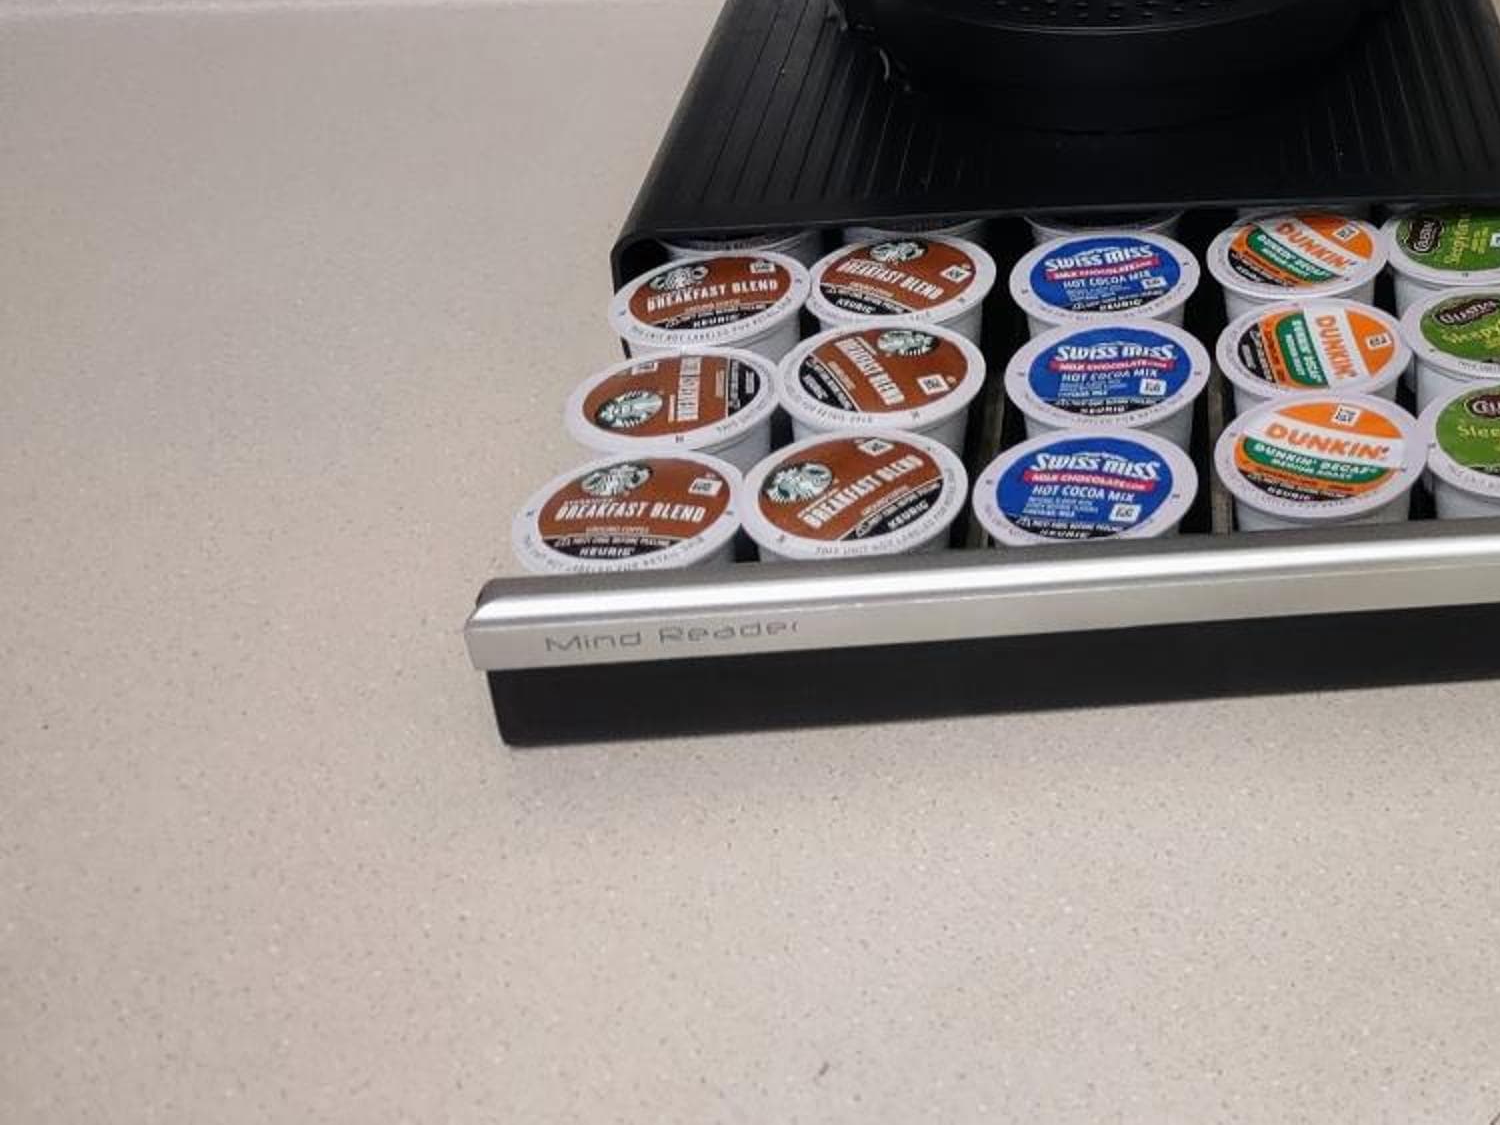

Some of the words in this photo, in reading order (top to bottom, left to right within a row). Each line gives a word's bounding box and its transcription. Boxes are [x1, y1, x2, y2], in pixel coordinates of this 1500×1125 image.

[835, 259, 905, 284] BREAKFAST
[900, 272, 944, 300] BLEND
[1089, 275, 1127, 287] COCOA
[647, 283, 726, 312] BREAKFAST
[732, 279, 778, 294] BLEND
[1062, 372, 1086, 383] HOT
[1090, 371, 1130, 380] COCOA
[1134, 368, 1158, 378] MIX
[1319, 461, 1372, 475] DECAF
[802, 474, 883, 529] BREAKFAST
[875, 454, 924, 483] BLEND
[1032, 485, 1059, 496] HOT
[1062, 486, 1105, 500] COCOA
[1108, 492, 1137, 503] MIX
[555, 501, 646, 522] BREAKFAST
[651, 502, 707, 523] BLEND
[887, 500, 929, 530] KEURIG
[545, 631, 642, 652] Mind
[659, 619, 799, 644] Reader
